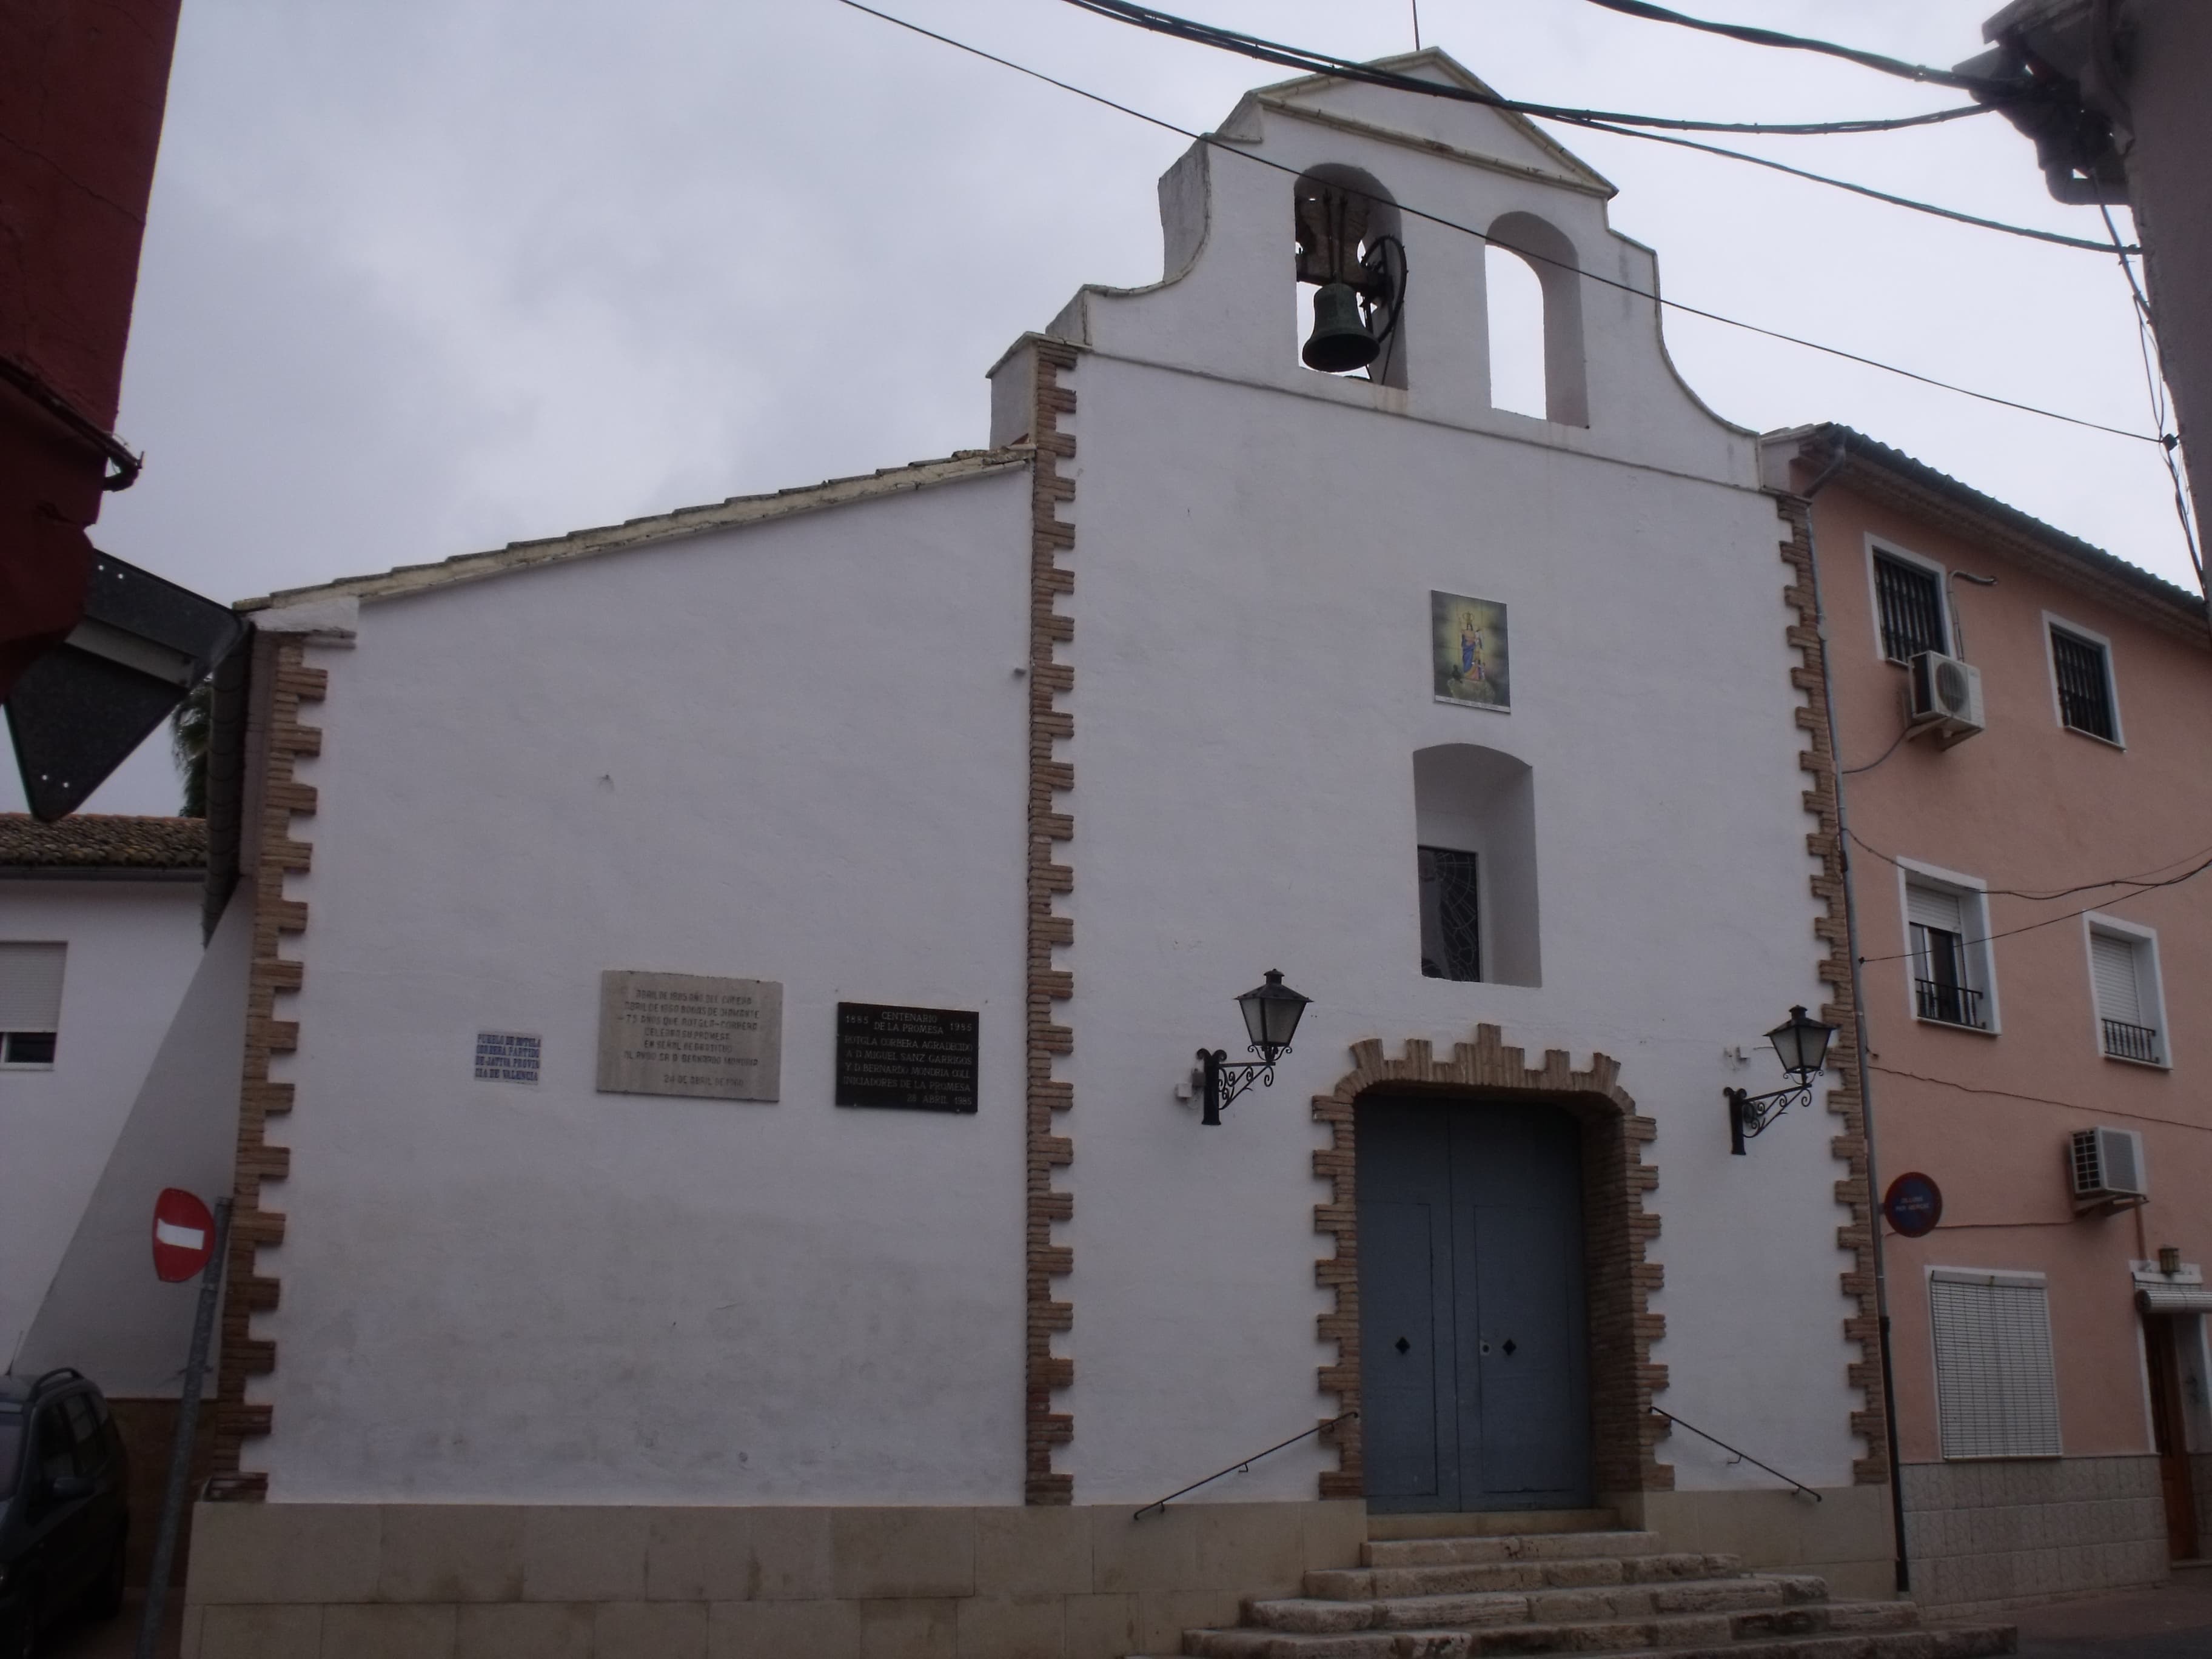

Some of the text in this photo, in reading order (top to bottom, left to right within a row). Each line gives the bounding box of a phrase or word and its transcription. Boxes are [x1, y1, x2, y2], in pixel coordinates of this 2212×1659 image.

[648, 1002, 659, 1013] DE
[708, 1007, 718, 1016] DE
[663, 1016, 679, 1026] QUE
[882, 1011, 937, 1023] CENTENARIO
[682, 1030, 692, 1038] SU
[873, 1021, 944, 1035] DE LA PROMESA
[881, 1037, 918, 1048] CORBERA
[921, 1041, 973, 1051] AGRADECIDO
[846, 1050, 853, 1058] A
[864, 1050, 898, 1061] MIGUEL
[900, 1053, 926, 1063] SANZ
[928, 1055, 972, 1065] GARRIGOS
[844, 1062, 852, 1071] Y
[863, 1063, 908, 1075] BERNARDO
[952, 1069, 971, 1079] COLL
[677, 1075, 688, 1084] DE
[843, 1076, 971, 1093] INICIADORES DE LA PROMESA
[922, 1094, 949, 1105] ABRIL
[954, 1096, 973, 1105] 1985
